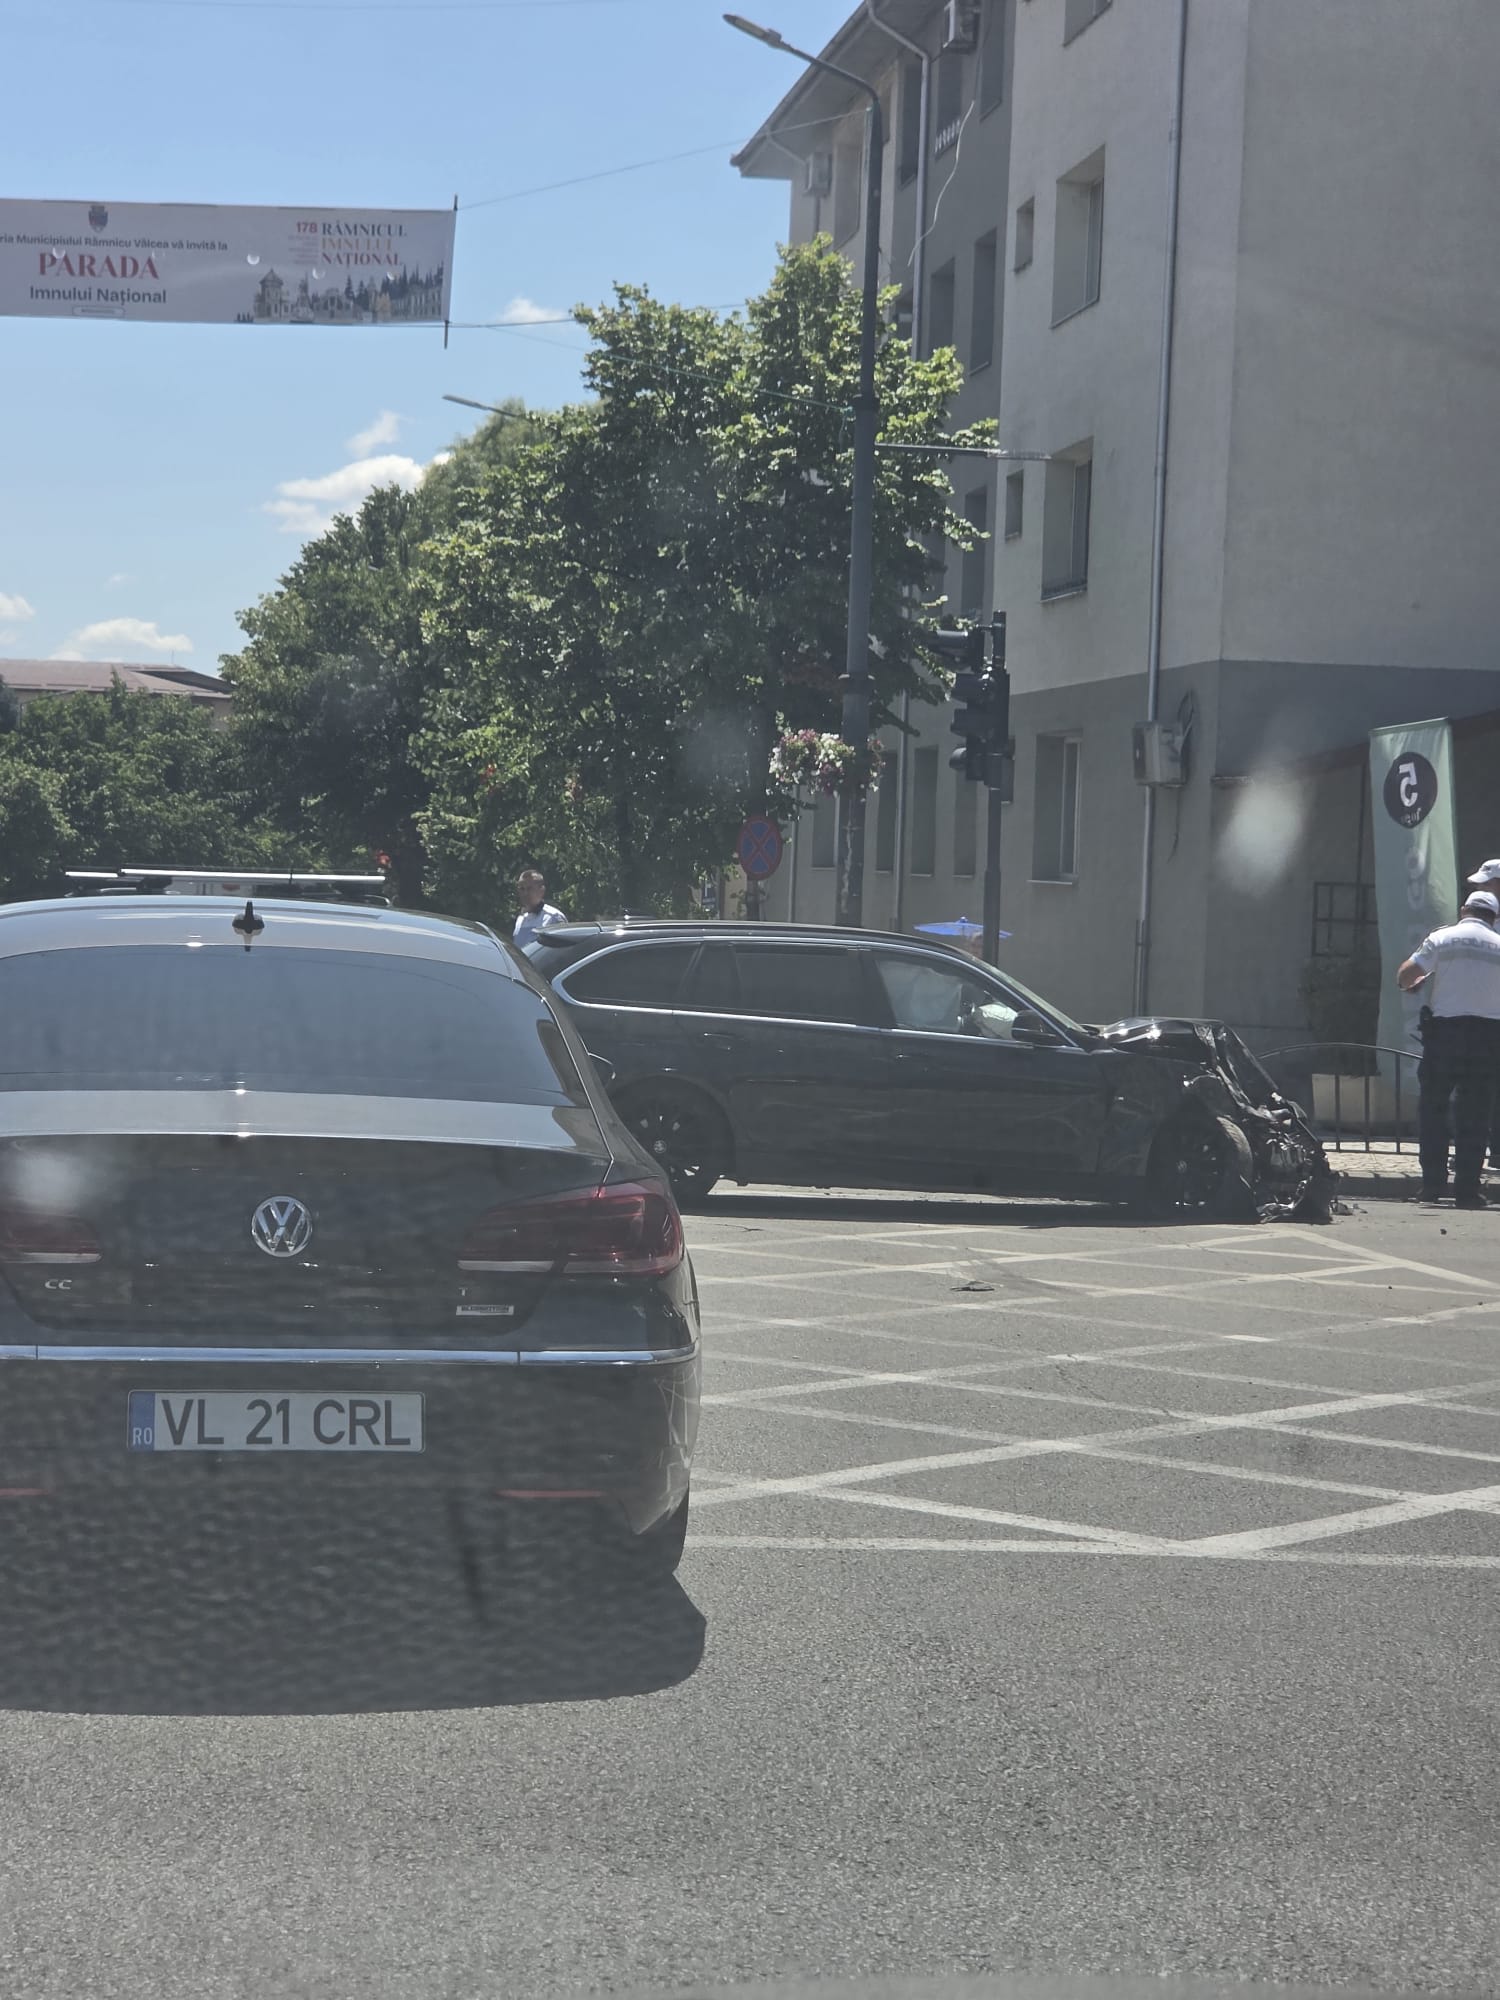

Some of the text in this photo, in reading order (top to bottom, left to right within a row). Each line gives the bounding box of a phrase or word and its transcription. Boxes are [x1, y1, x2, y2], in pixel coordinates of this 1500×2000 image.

[296, 222, 318, 233] 178
[321, 219, 408, 237] RÂMNICUL
[16, 234, 82, 247] Municipiului
[218, 240, 228, 251] la
[321, 238, 392, 251] IMNULUI
[39, 252, 160, 280] PARADA
[30, 286, 167, 305] Imnului Național
[44, 1279, 73, 1290] CC
[161, 1399, 412, 1446] VL 21 CRL
[132, 1428, 153, 1446] RO
